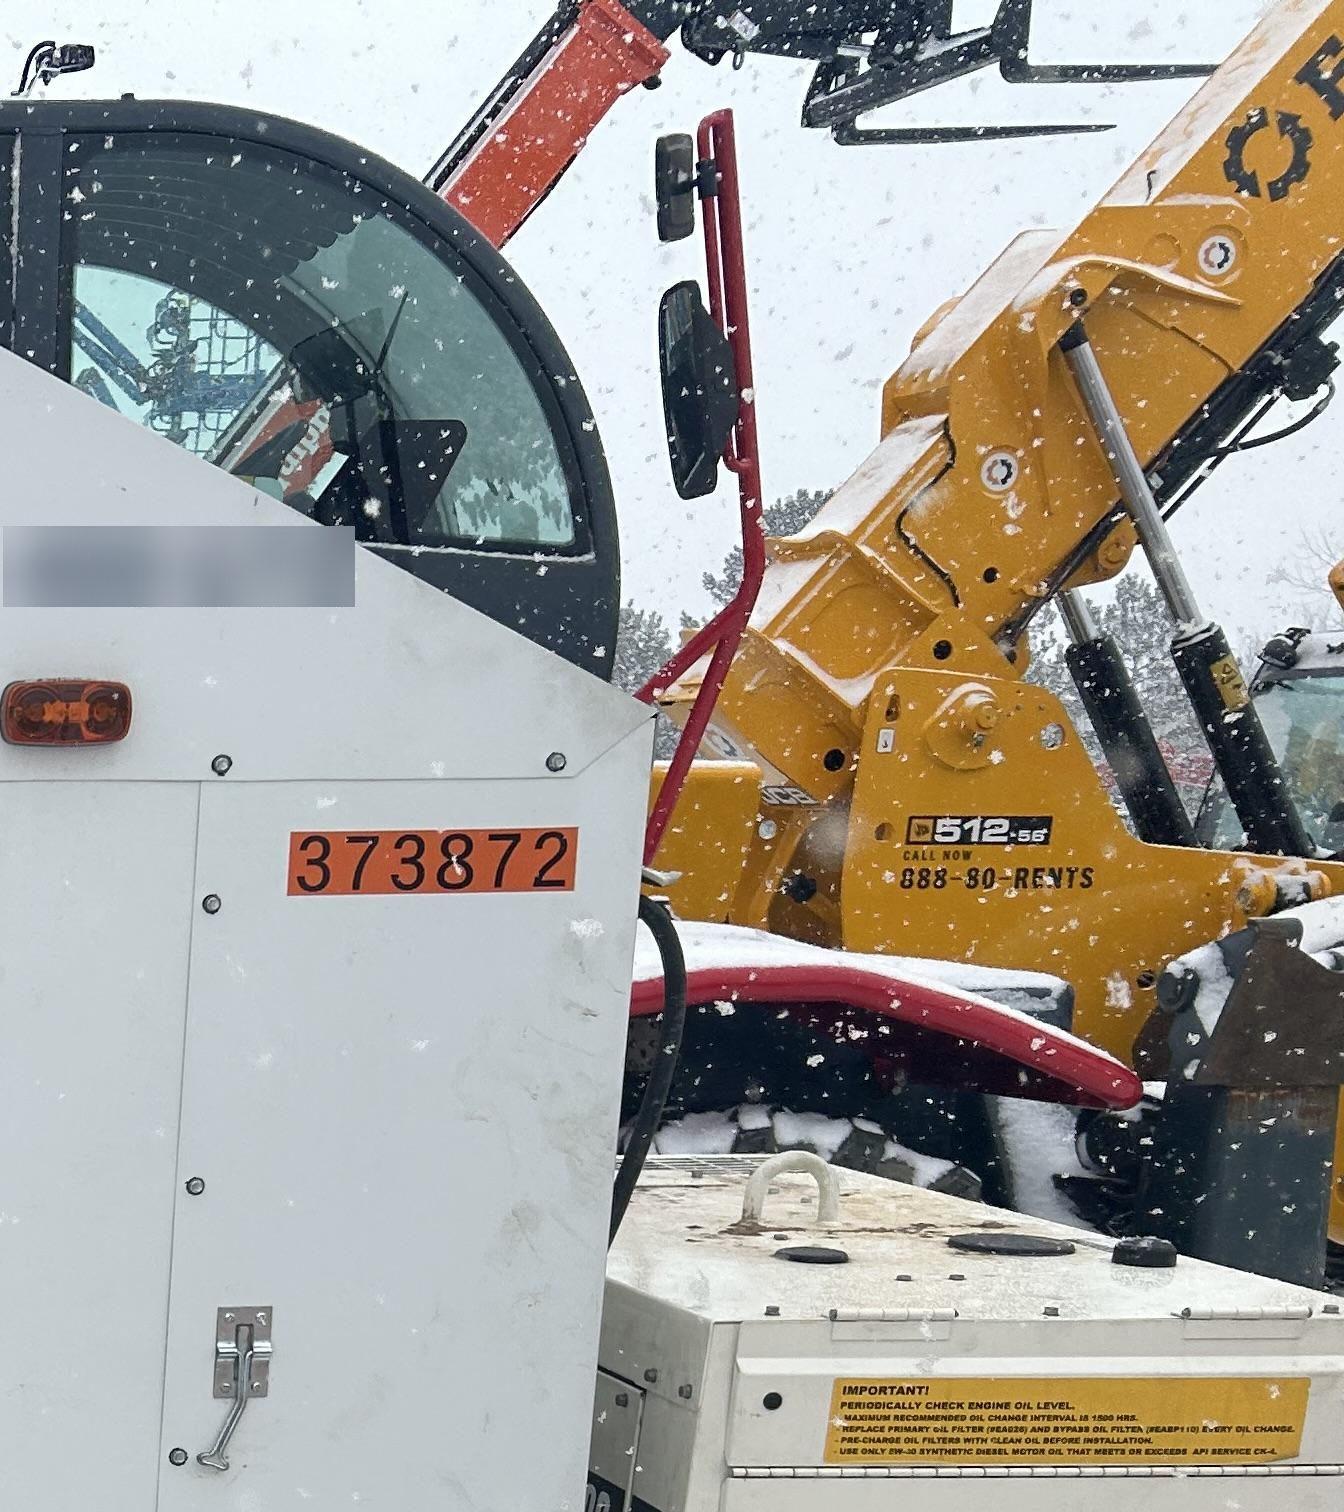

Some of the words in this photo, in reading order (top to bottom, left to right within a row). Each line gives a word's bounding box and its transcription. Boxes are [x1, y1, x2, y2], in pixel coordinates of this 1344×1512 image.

[903, 850, 937, 861] CALL
[942, 850, 973, 861] NOW
[295, 831, 570, 892] 373872
[900, 866, 1095, 890] 888-80-RENTS
[842, 1385, 930, 1396] IMPORTANT!
[840, 1401, 921, 1410] PERIODICALLY
[925, 1401, 965, 1410] CHECK
[968, 1401, 1011, 1410] ENGINE
[1014, 1401, 1033, 1410] OIL
[1036, 1401, 1075, 1410] LEVEL.
[844, 1414, 891, 1422] MAXIMUM
[893, 1414, 967, 1422] RECOMMENDED
[969, 1414, 986, 1422] OIL
[988, 1414, 1028, 1422] CHANGE
[1030, 1414, 1077, 1422] INTERVAL
